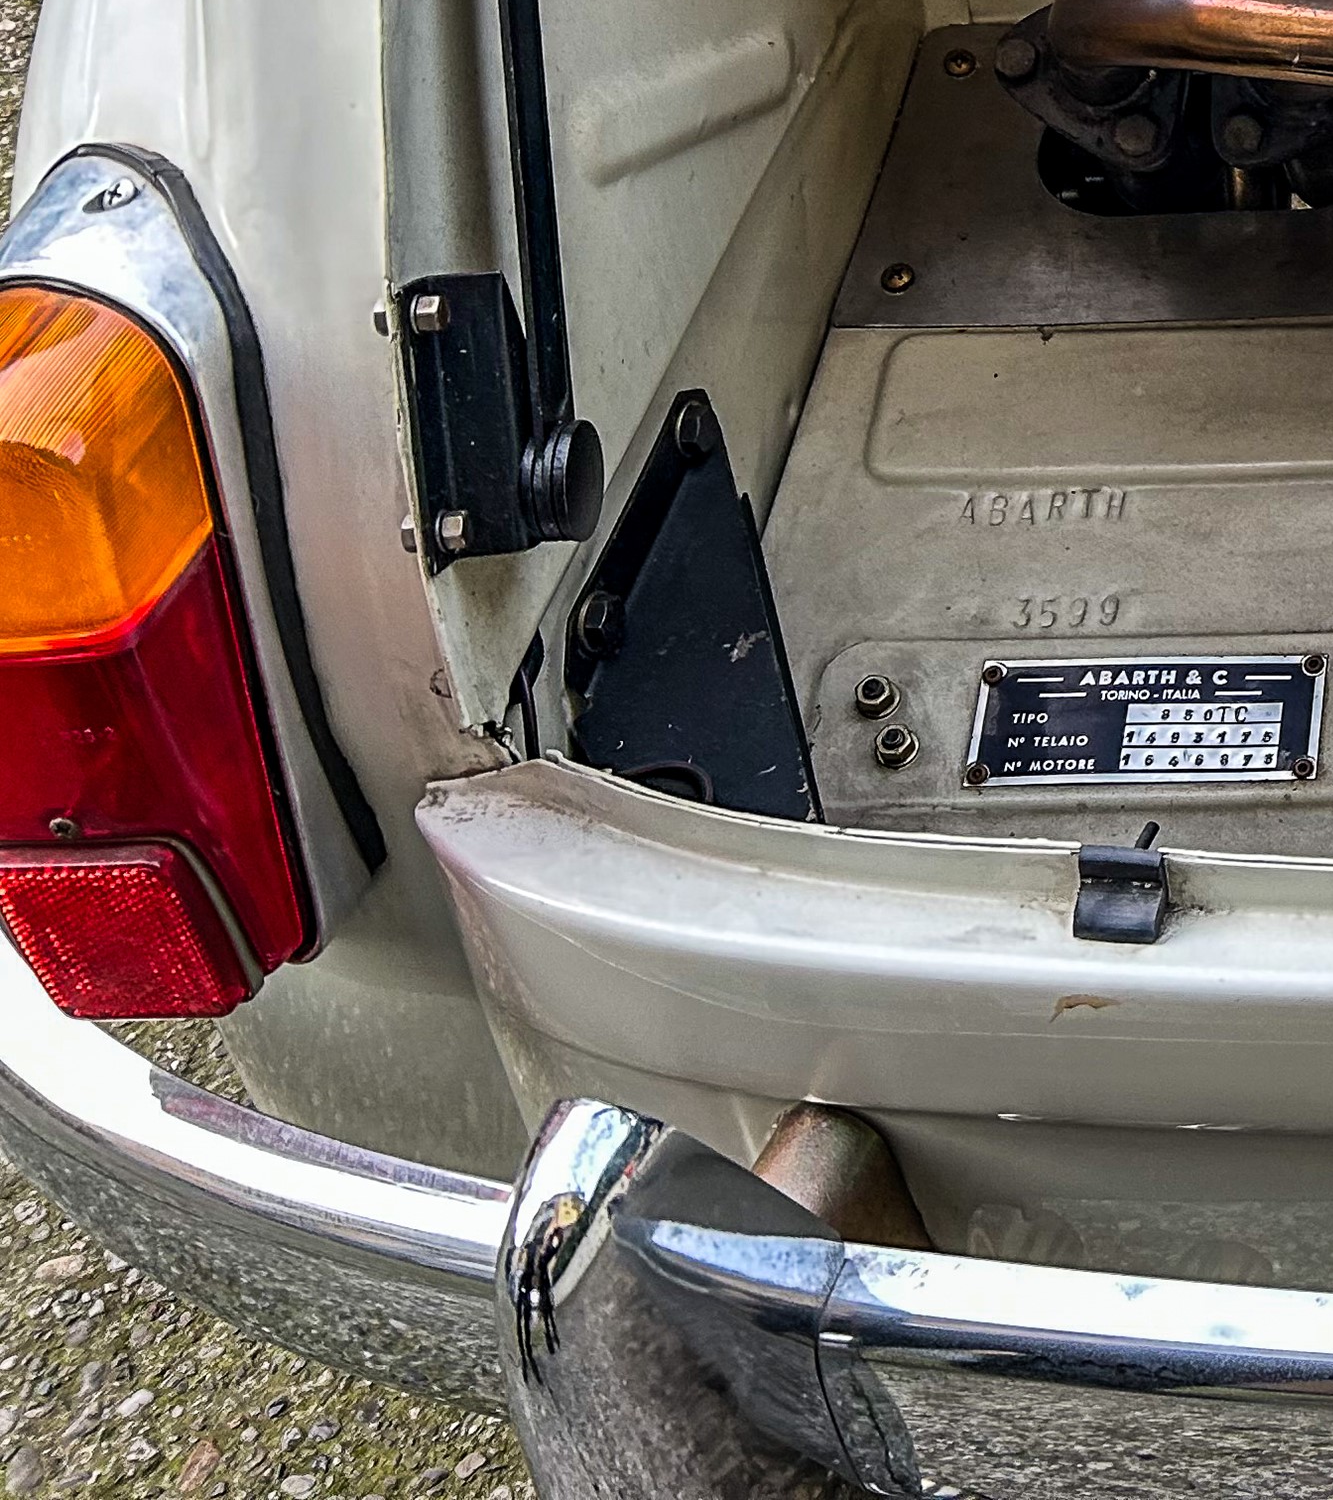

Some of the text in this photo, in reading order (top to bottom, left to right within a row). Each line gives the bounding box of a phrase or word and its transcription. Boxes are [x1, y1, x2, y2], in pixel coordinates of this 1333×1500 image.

[958, 488, 1128, 526] ABARTH
[1013, 594, 1122, 630] 3599
[1078, 670, 1229, 686] ABARTH & C
[1100, 689, 1150, 701] TORINO
[1162, 688, 1201, 700] ITALIA
[1011, 712, 1050, 725] TIPO
[1033, 735, 1089, 748] TELAIO
[1029, 758, 1096, 772] MOTORE
